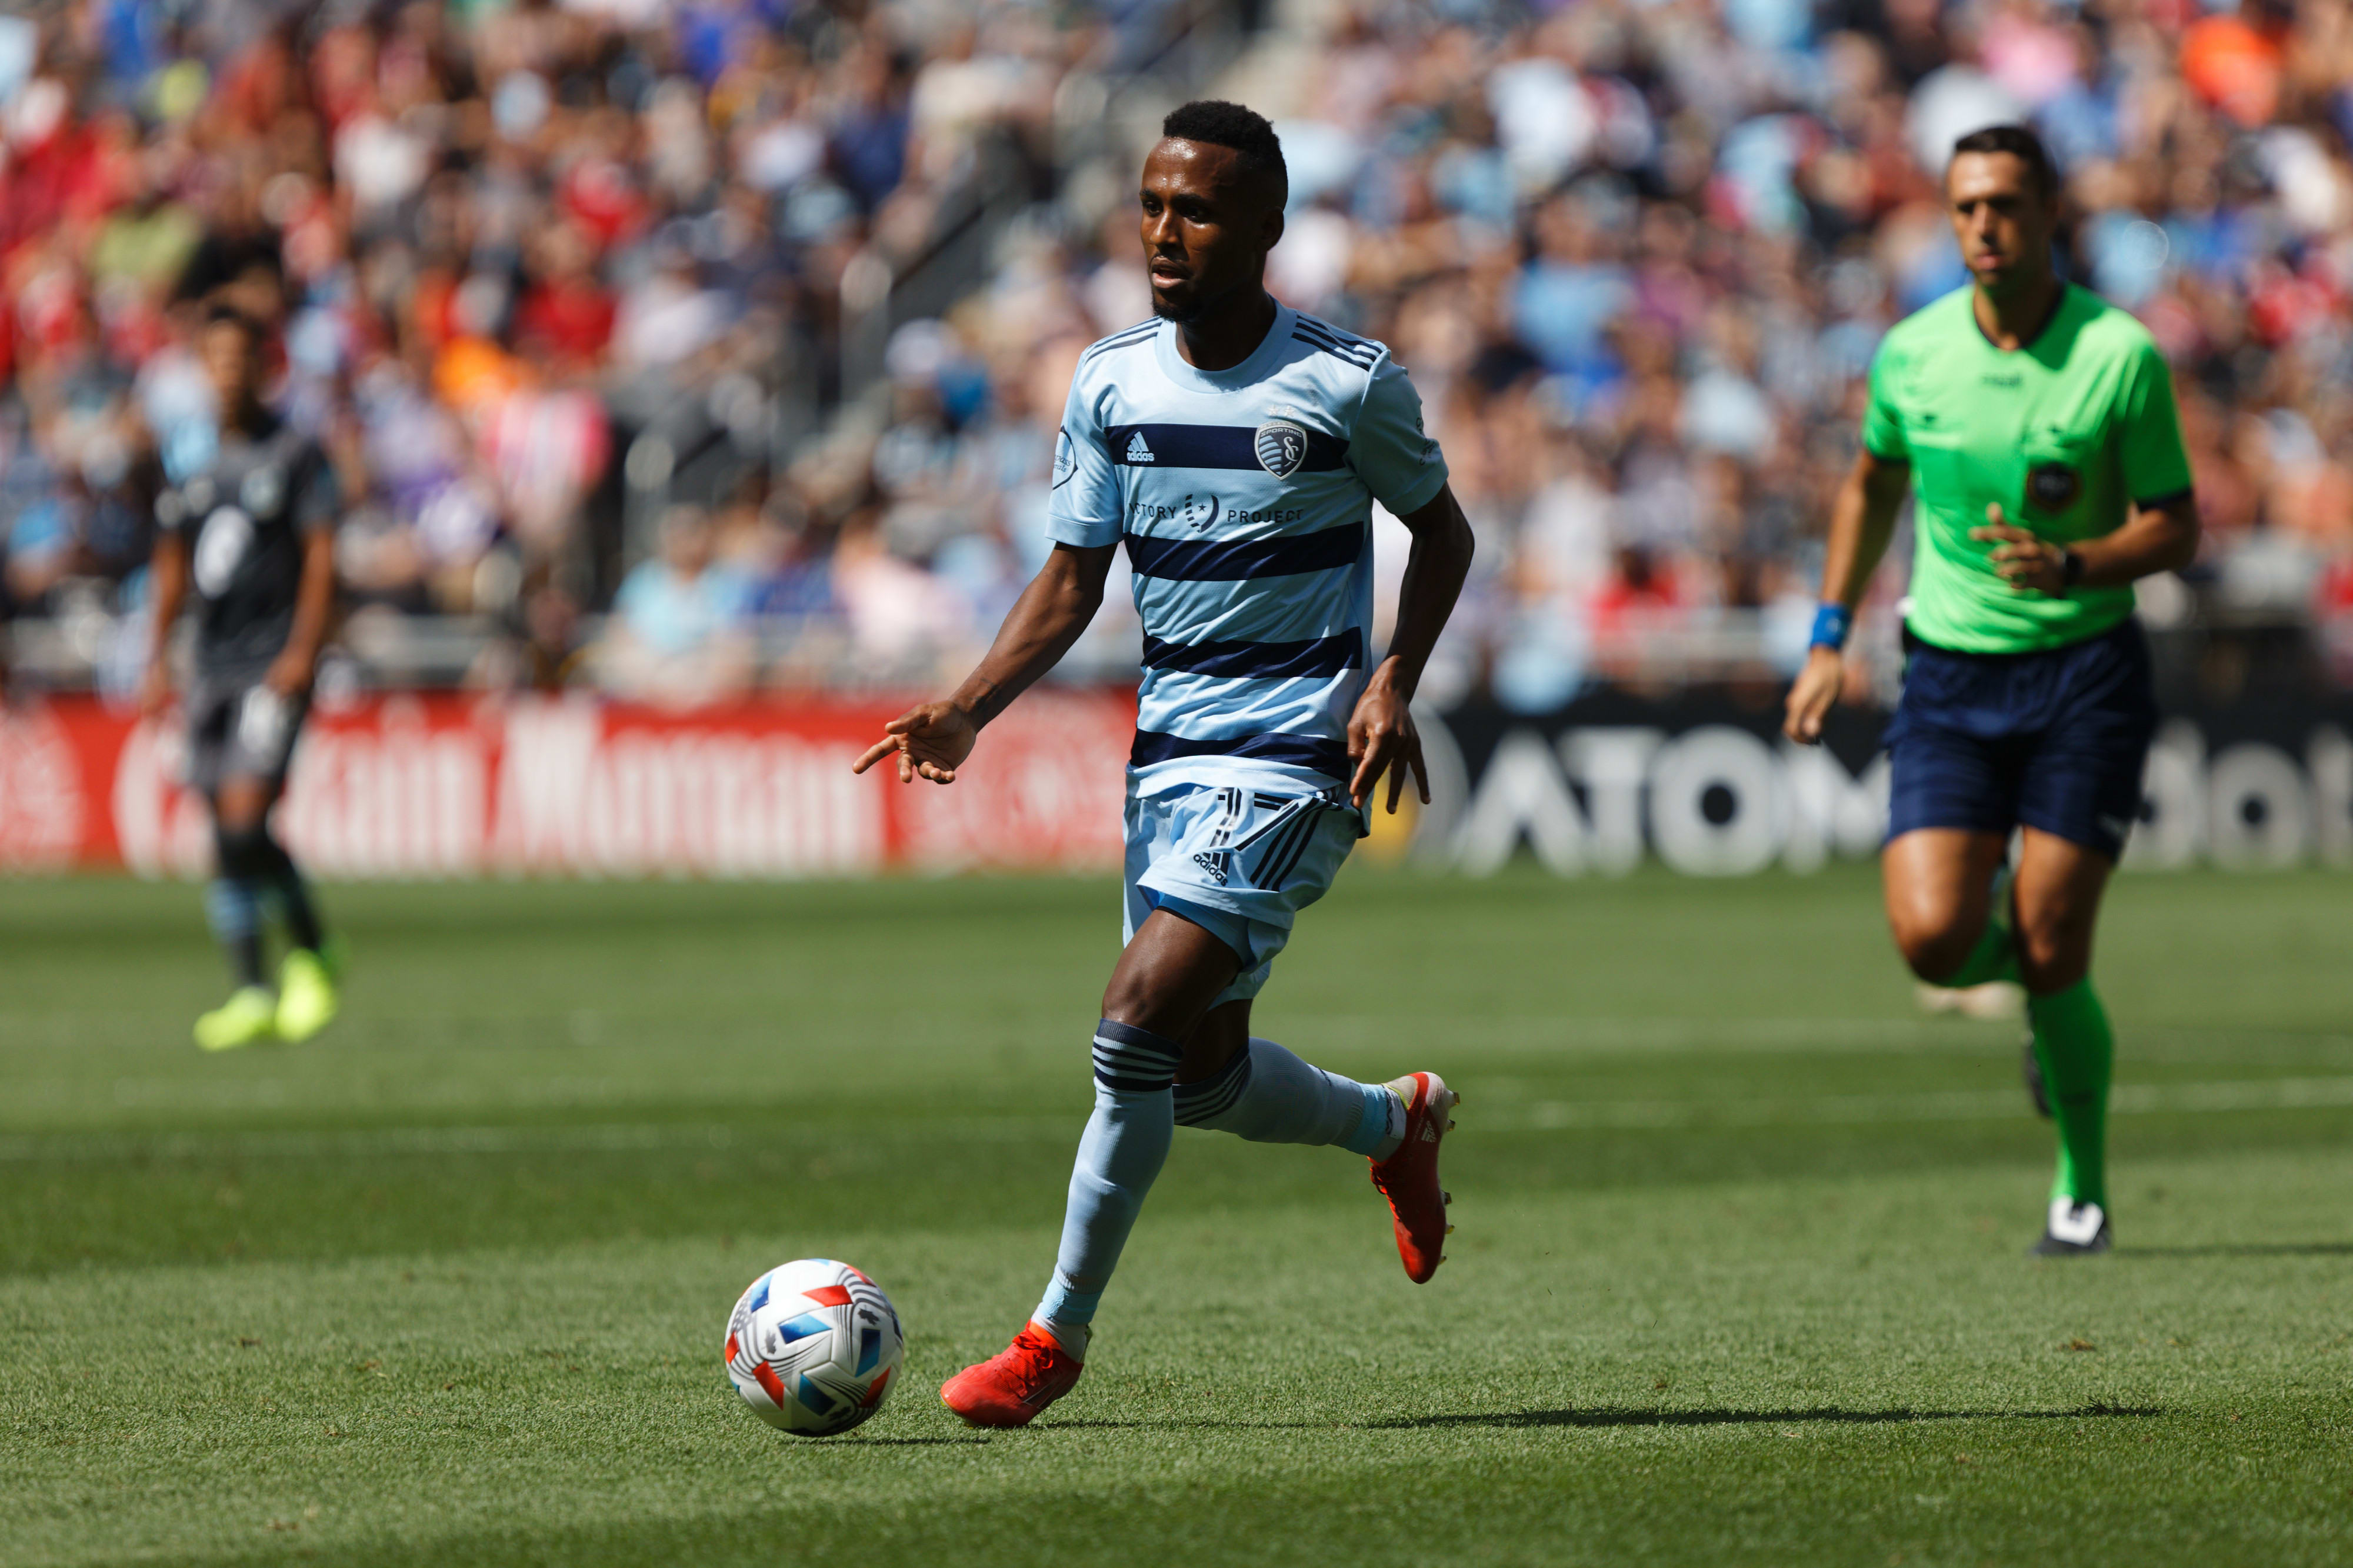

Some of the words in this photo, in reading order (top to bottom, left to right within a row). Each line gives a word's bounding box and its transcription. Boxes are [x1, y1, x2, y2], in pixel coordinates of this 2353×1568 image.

[1261, 428, 1302, 438] SPORTING
[1126, 452, 1155, 462] adidas
[1228, 509, 1304, 523] PROJECT
[1459, 725, 1891, 876] ATOM
[1193, 854, 1228, 886] adidas
